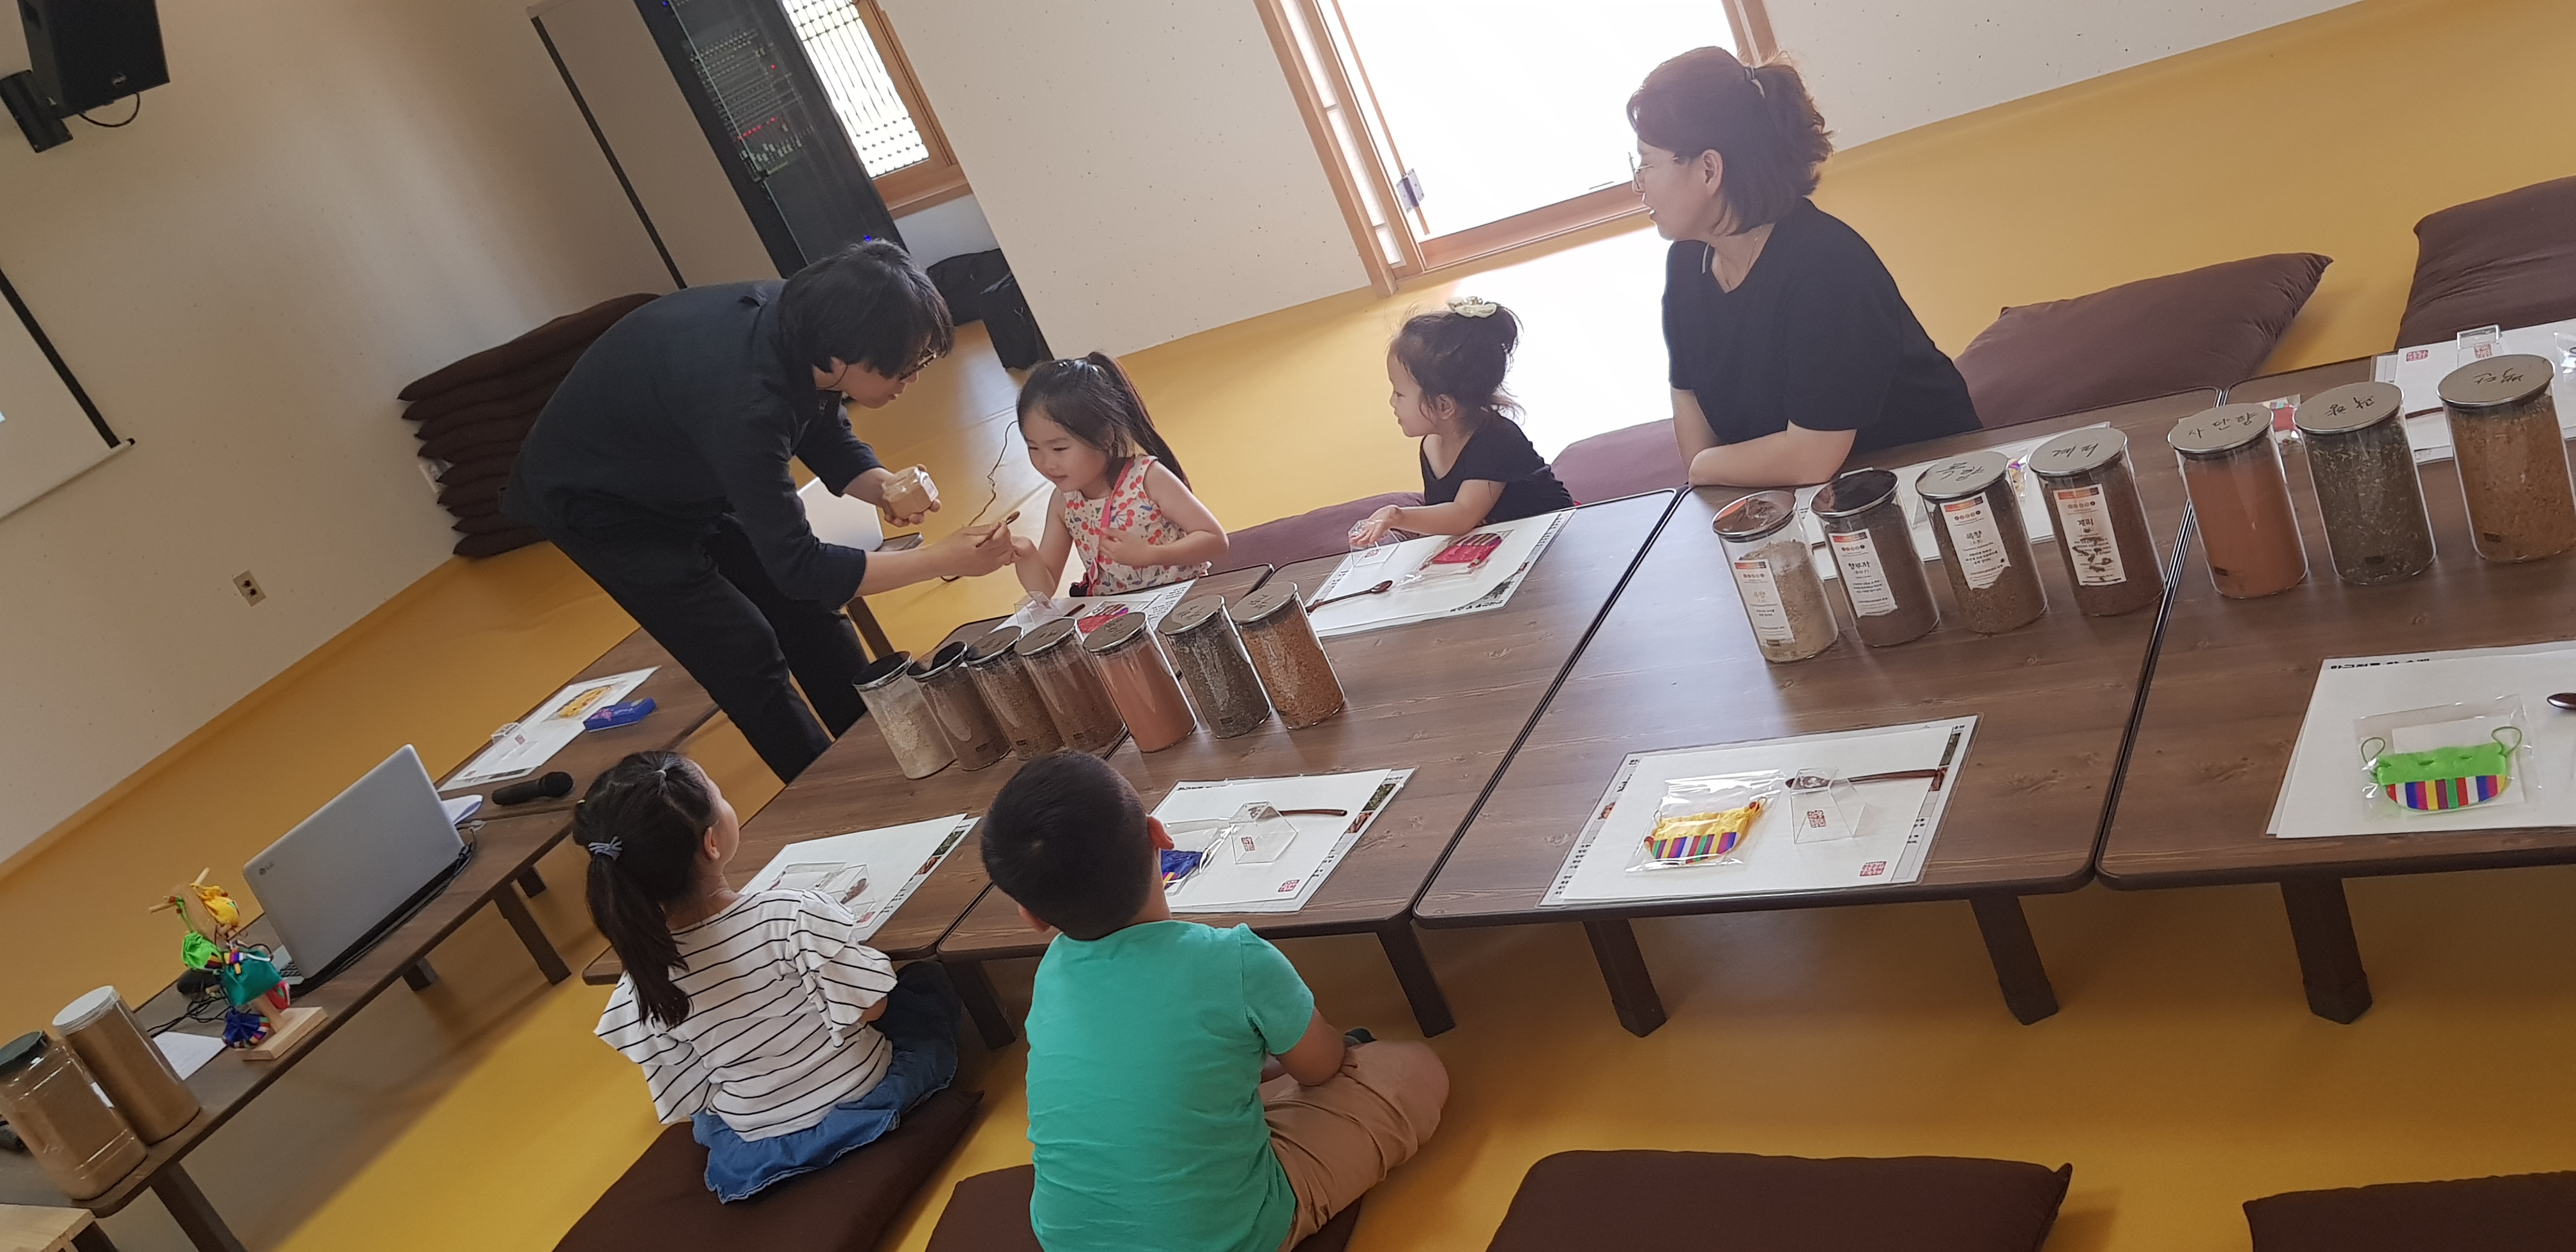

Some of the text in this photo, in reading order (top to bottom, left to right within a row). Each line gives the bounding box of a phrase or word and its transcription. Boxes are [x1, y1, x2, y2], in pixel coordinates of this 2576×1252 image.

[2051, 443, 2099, 458] 계피
[2076, 518, 2094, 526] 계피
[1848, 561, 1871, 570] 향부자
